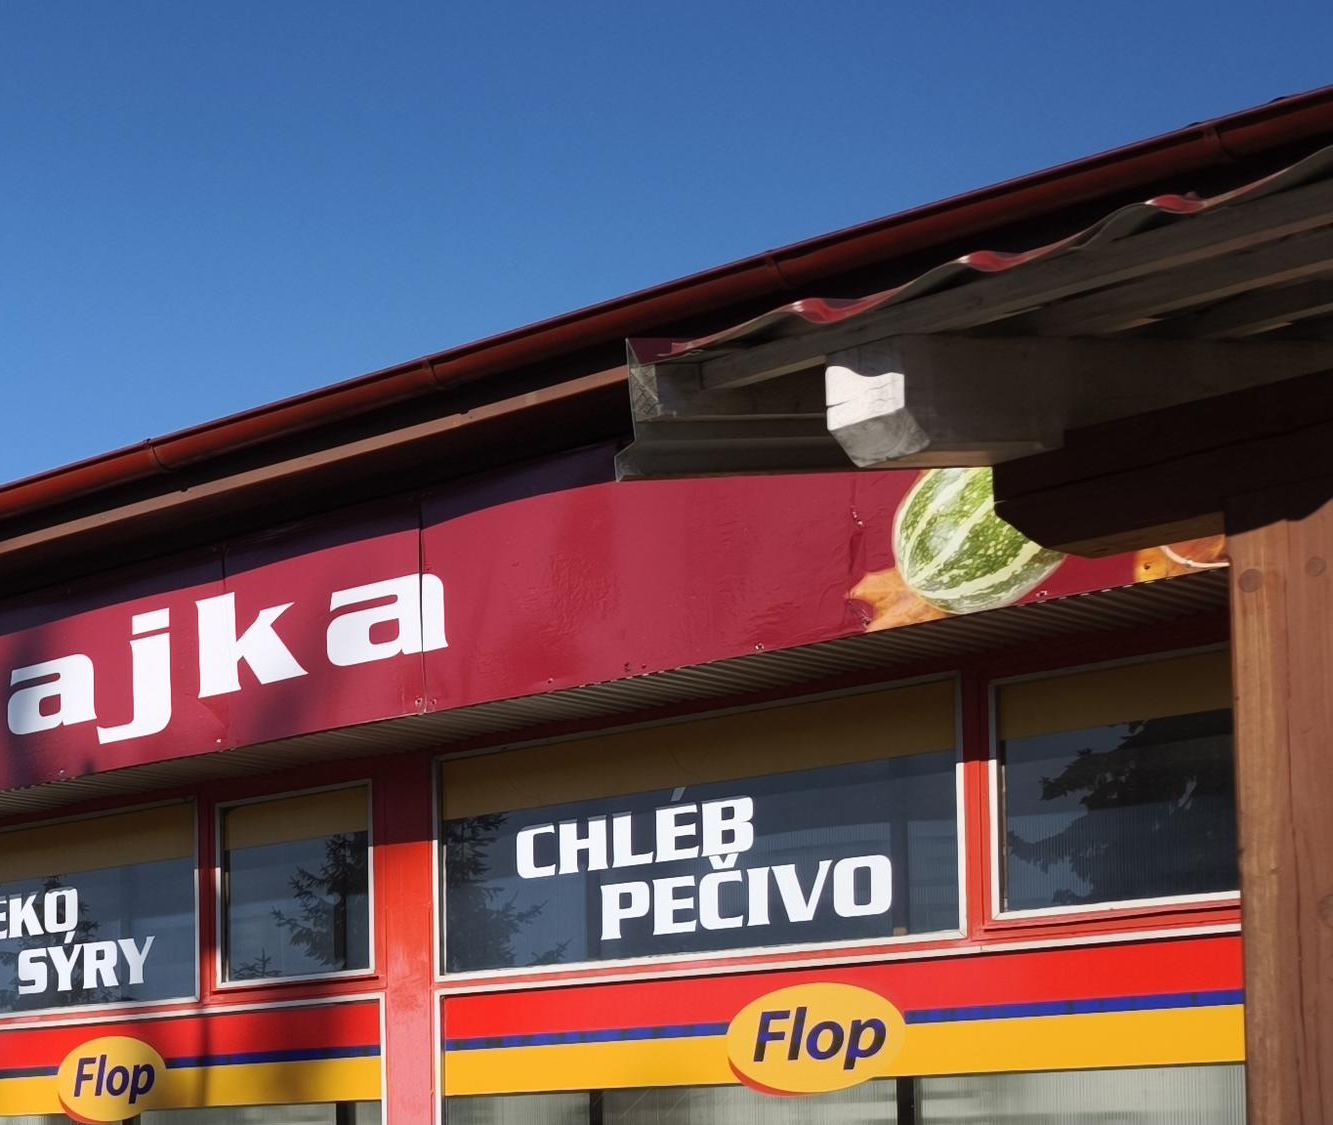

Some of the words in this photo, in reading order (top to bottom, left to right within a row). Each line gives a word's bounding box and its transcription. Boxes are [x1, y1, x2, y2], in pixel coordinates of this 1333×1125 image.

[516, 787, 754, 880] CHLÉB
[600, 854, 893, 941] PEČIVO
[17, 934, 155, 995] SÝRY
[752, 1007, 887, 1070] Flop
[73, 1054, 156, 1105] Flop
